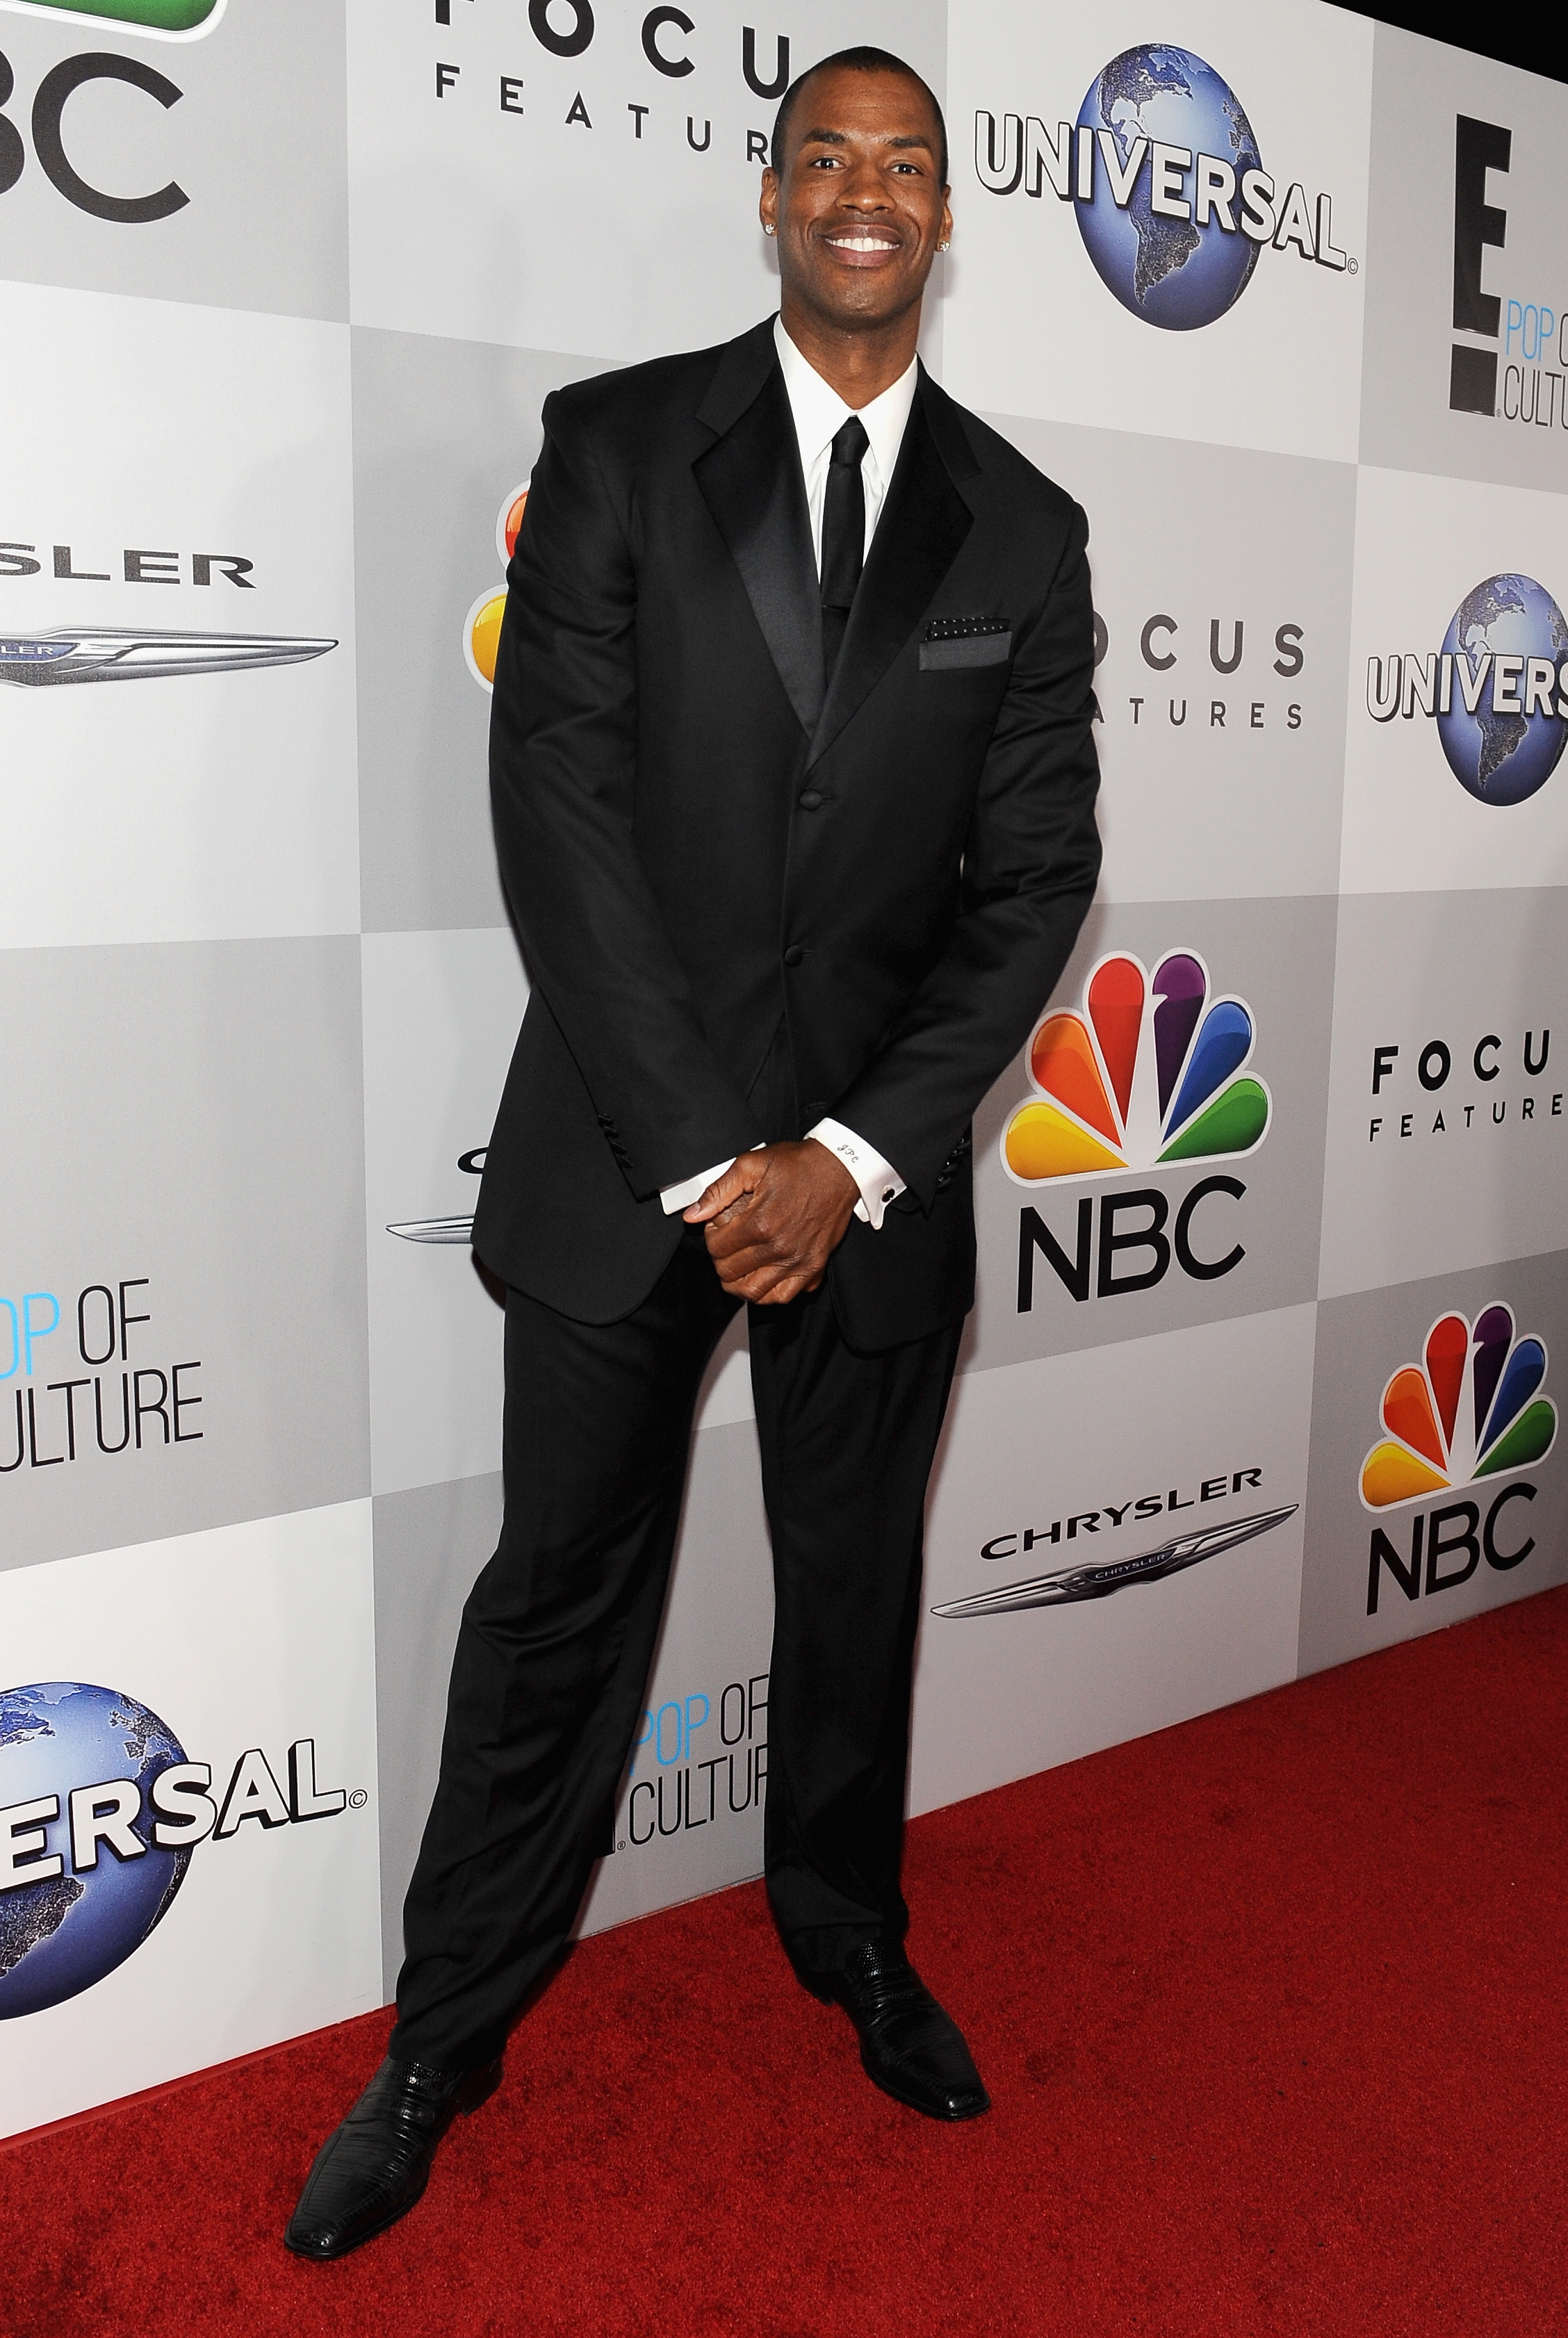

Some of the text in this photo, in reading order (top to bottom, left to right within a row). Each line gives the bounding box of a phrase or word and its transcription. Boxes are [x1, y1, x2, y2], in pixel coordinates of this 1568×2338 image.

[435, 0, 790, 100] OCU
[1506, 300, 1554, 361] POP
[1093, 610, 1305, 678] CUS
[1372, 1029, 1550, 1095] FOCU
[1369, 1093, 1563, 1143] FEATURE
[1017, 1175, 1248, 1314] NBC
[78, 1278, 151, 1365] OF
[980, 1467, 1263, 1561] CHRYSLER
[1366, 1482, 1538, 1617] NBC
[1095, 1554, 1165, 1579] CHRYSLER
[720, 1674, 769, 1746] OF
